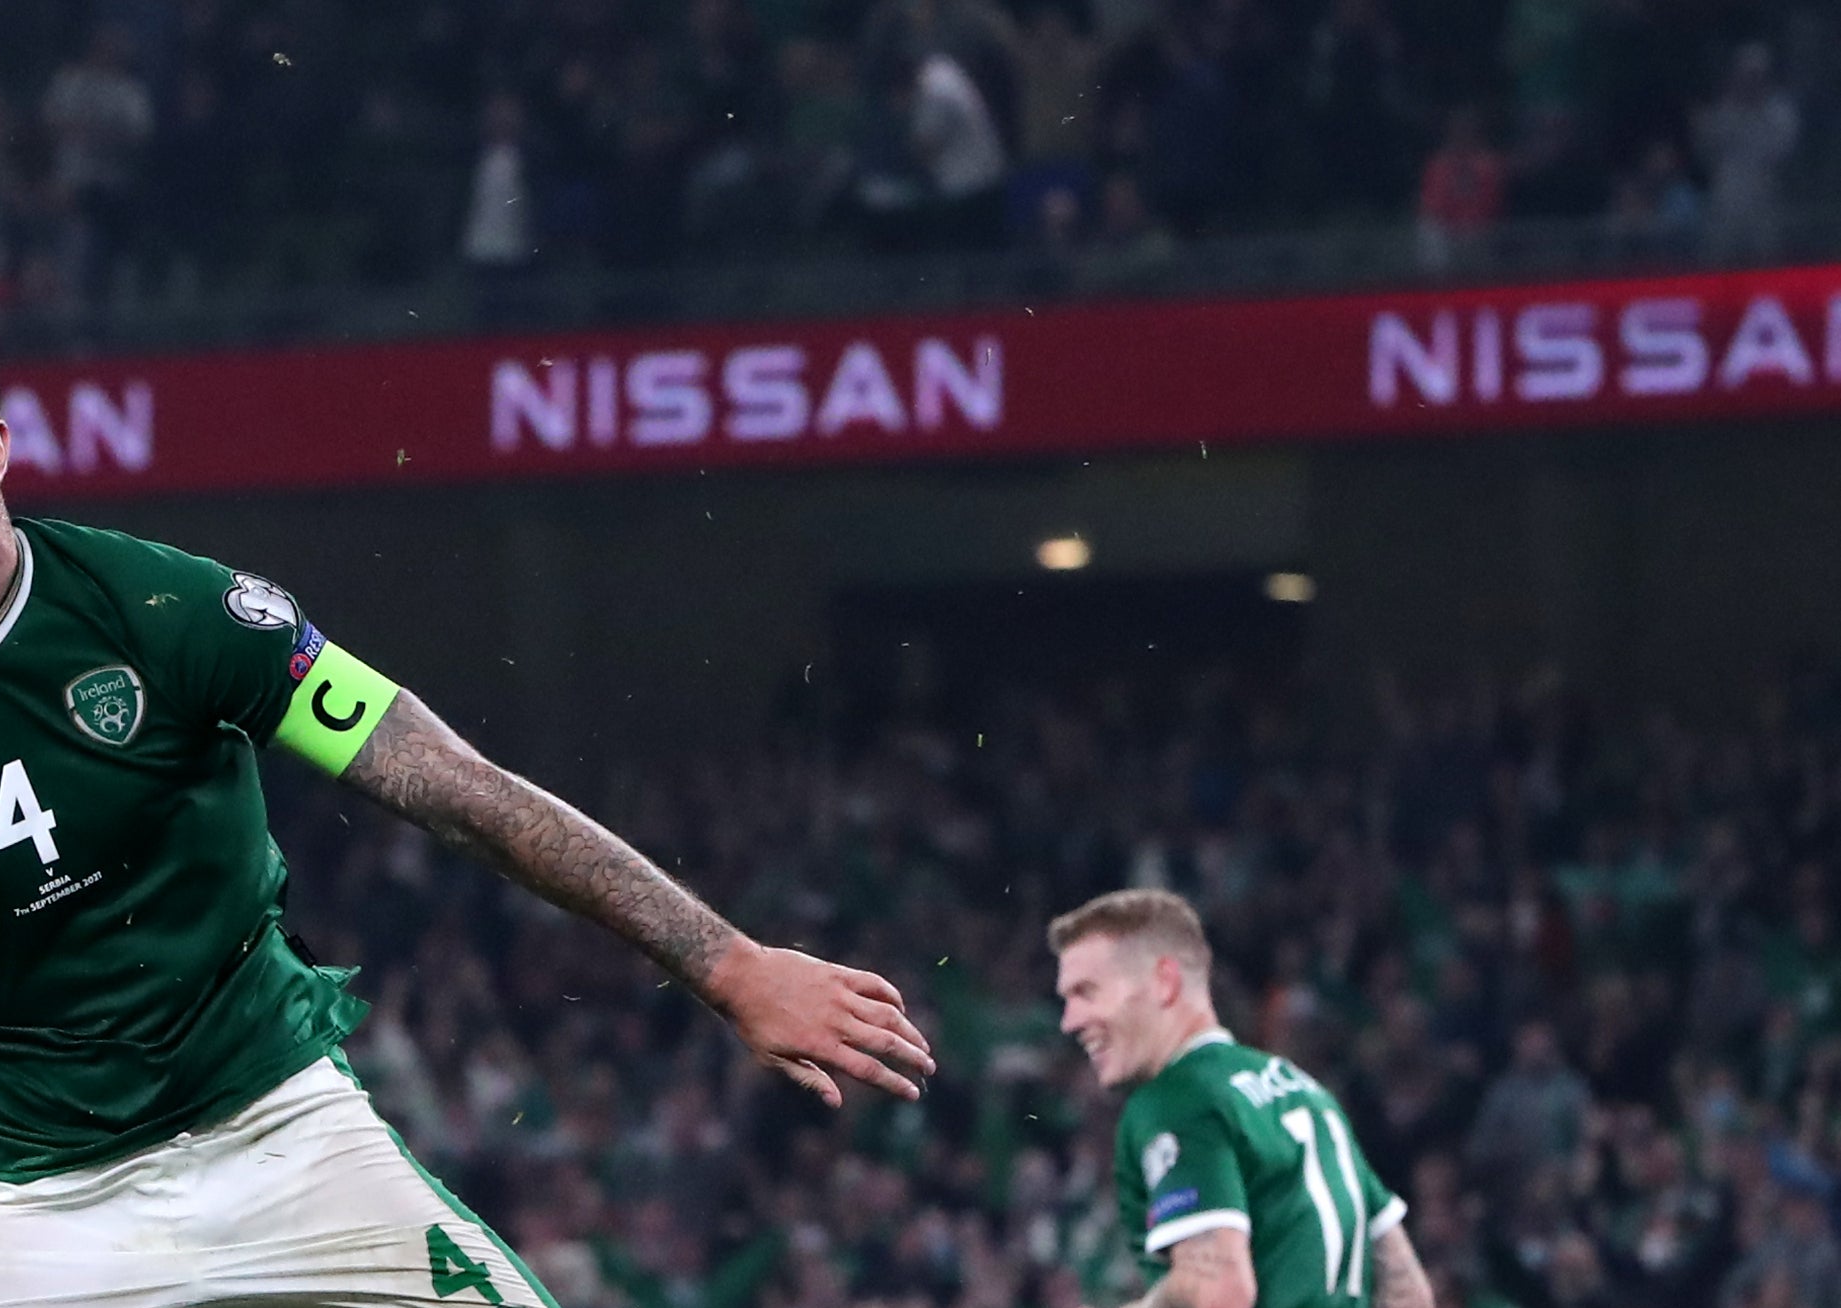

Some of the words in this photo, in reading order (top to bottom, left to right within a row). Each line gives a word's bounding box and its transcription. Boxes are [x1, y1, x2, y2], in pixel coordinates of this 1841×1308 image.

[1367, 294, 1841, 408] NISSA
[490, 334, 1003, 453] NISSAN
[77, 674, 126, 702] Ireland
[312, 679, 366, 732] C
[29, 882, 82, 912] SEPTEMBER
[82, 870, 103, 888] 2021
[39, 874, 72, 895] SERBIA
[1280, 1106, 1366, 1297] 11
[425, 1223, 505, 1305] 4
